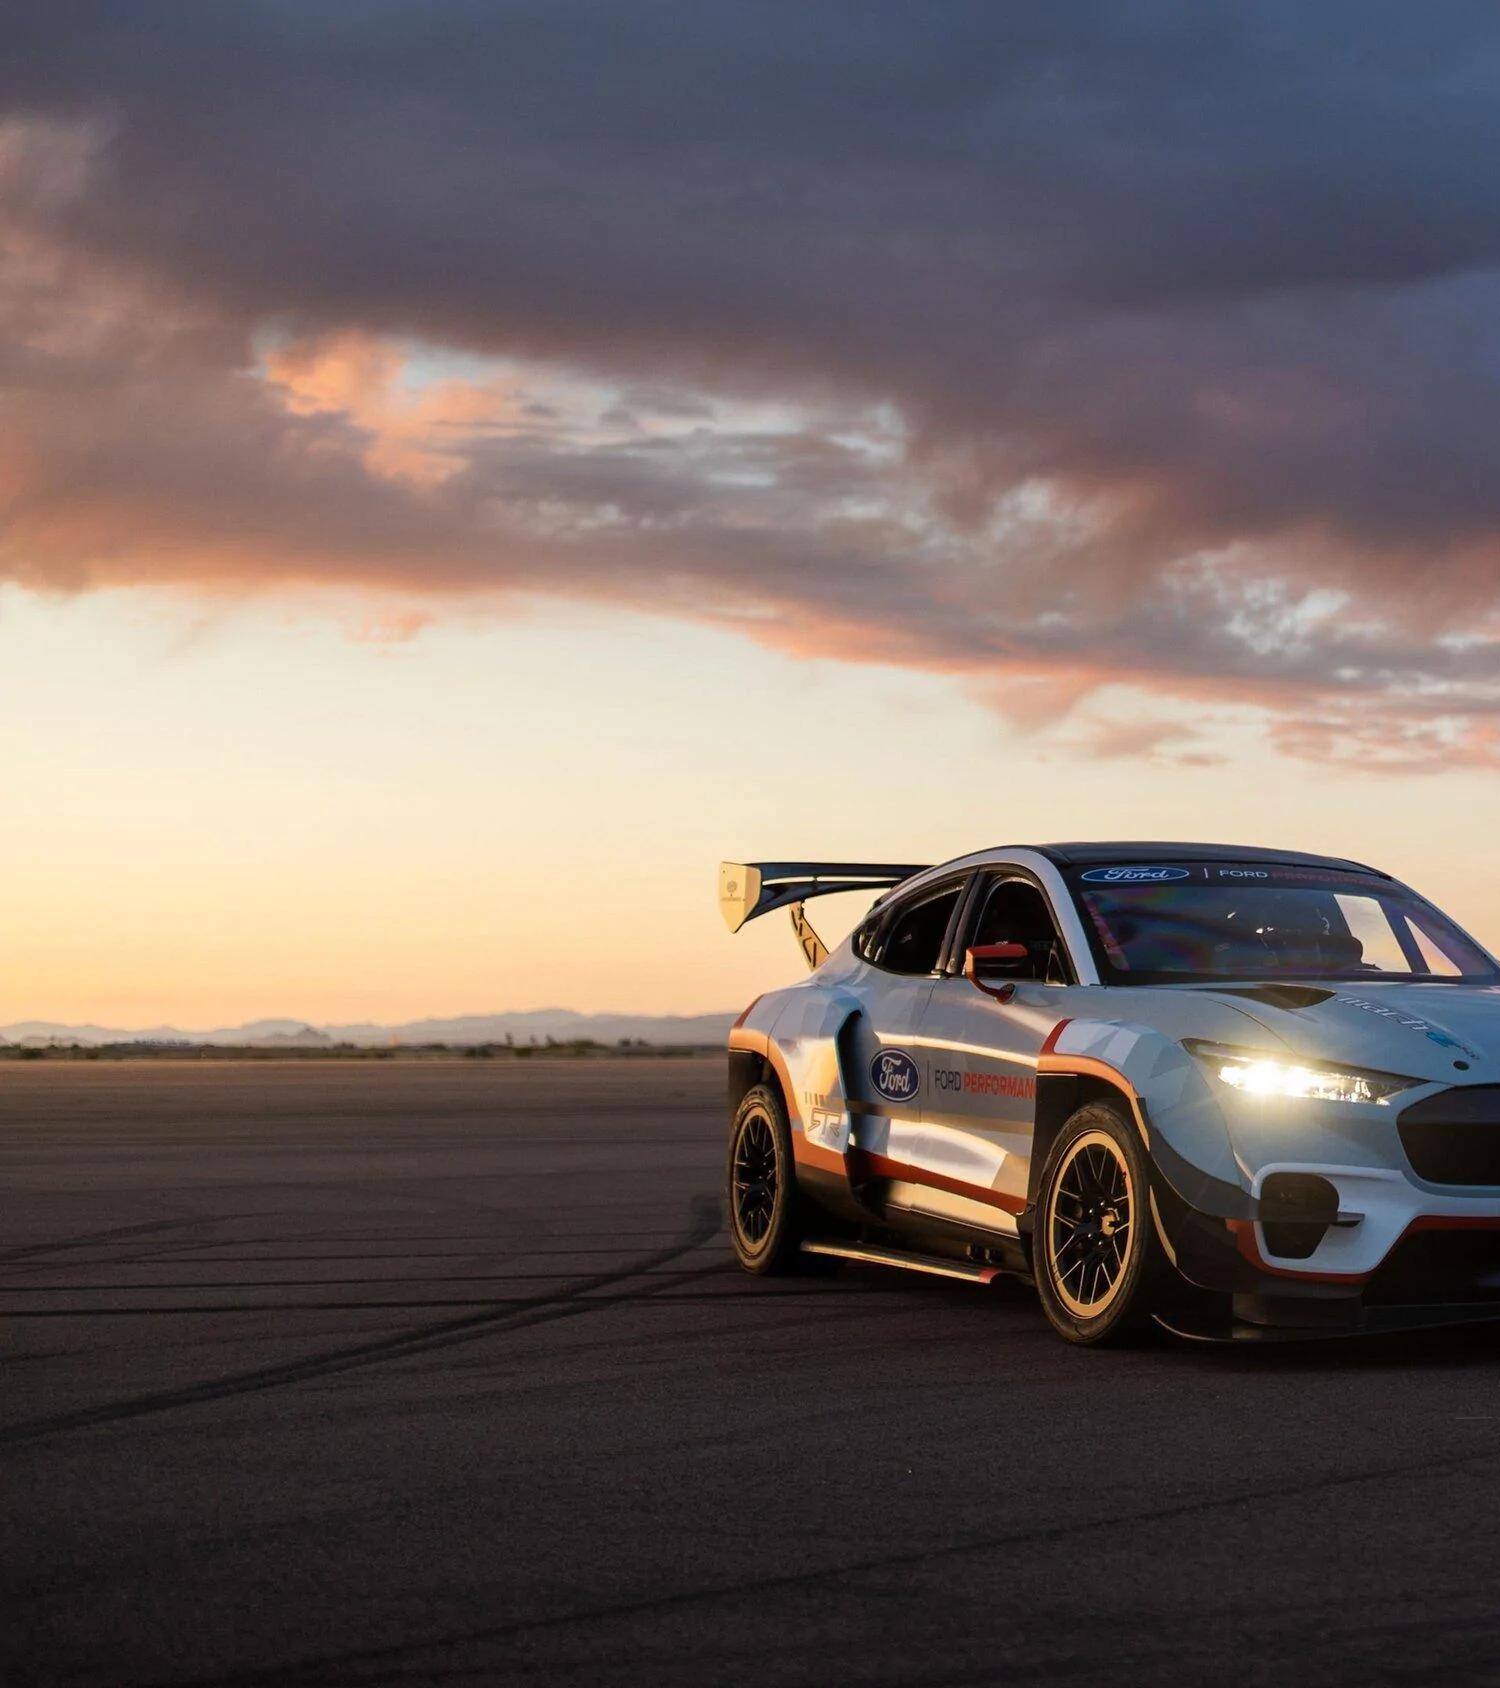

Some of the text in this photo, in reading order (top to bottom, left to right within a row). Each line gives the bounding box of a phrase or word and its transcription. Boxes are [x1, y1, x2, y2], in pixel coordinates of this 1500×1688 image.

[1104, 867, 1169, 880] Ford
[1219, 870, 1268, 879] FORD
[879, 1056, 1036, 1099] Ford FORD PERFORMAN
